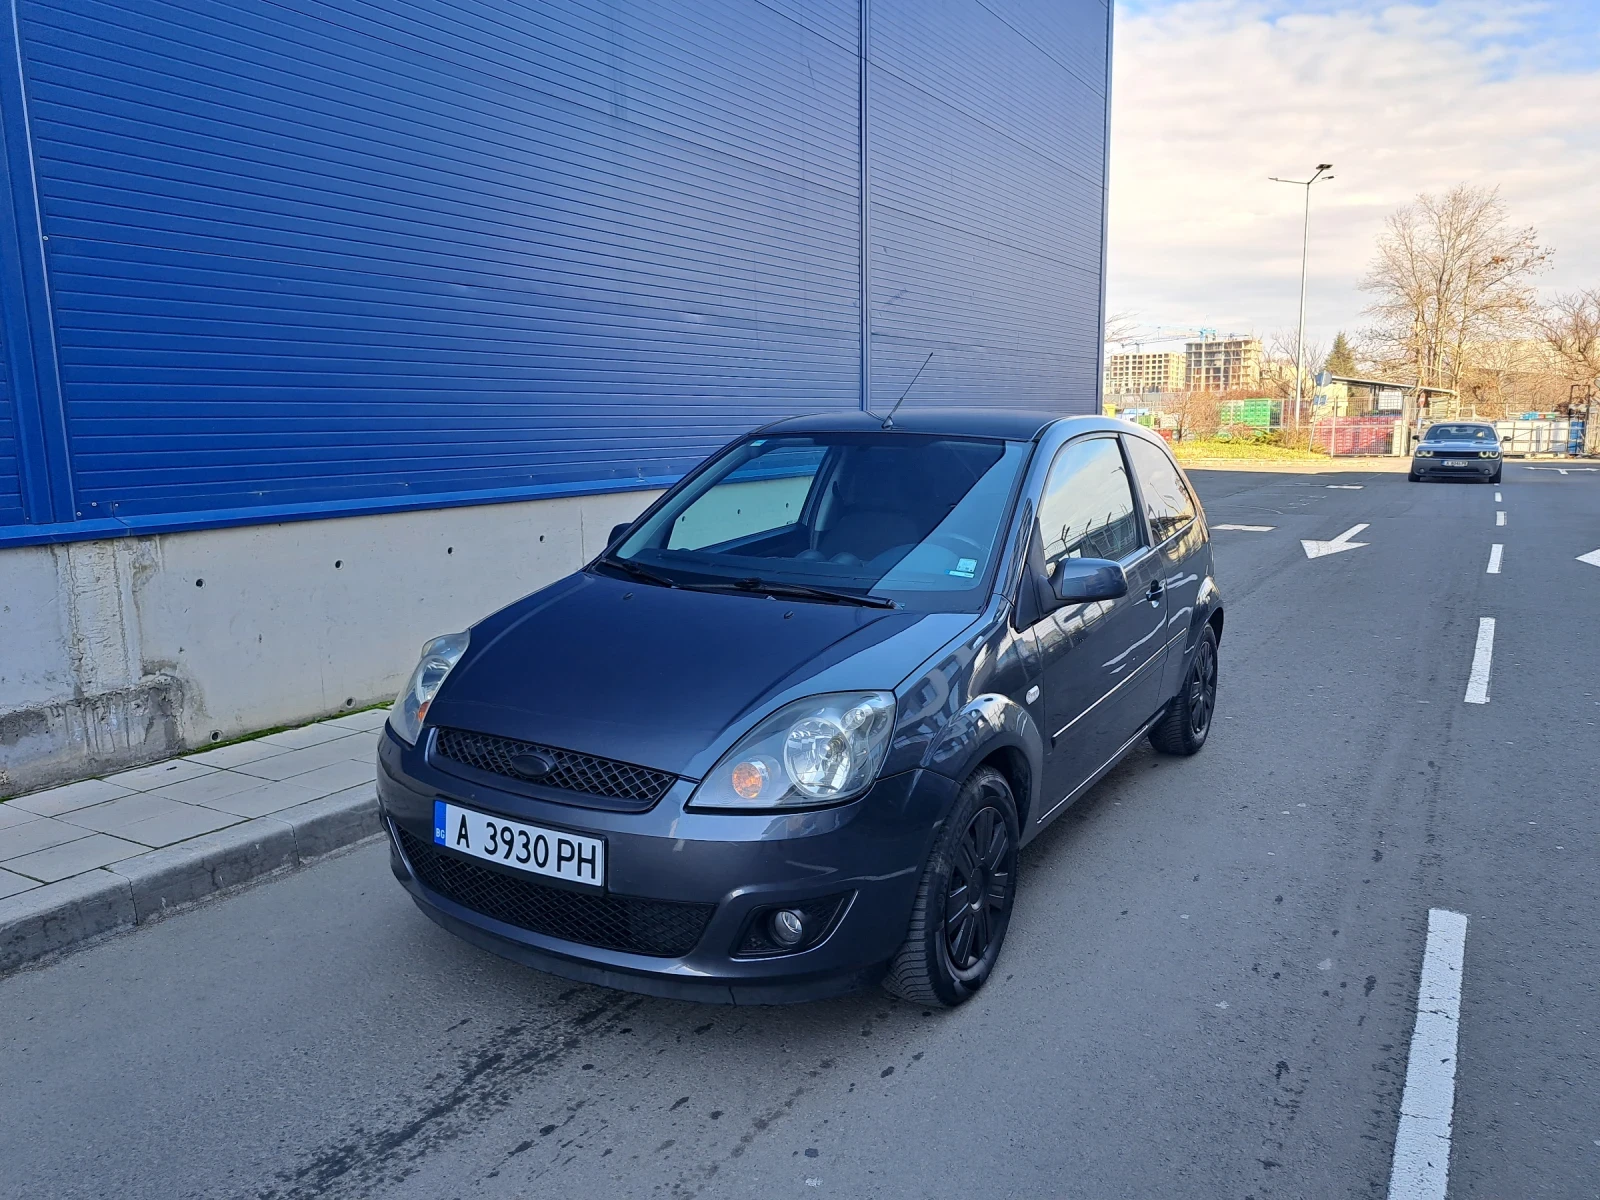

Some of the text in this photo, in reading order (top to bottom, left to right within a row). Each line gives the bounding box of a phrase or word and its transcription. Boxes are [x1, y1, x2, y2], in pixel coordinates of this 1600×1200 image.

[435, 827, 446, 839] BG
[456, 813, 596, 880] A 3930 PH
